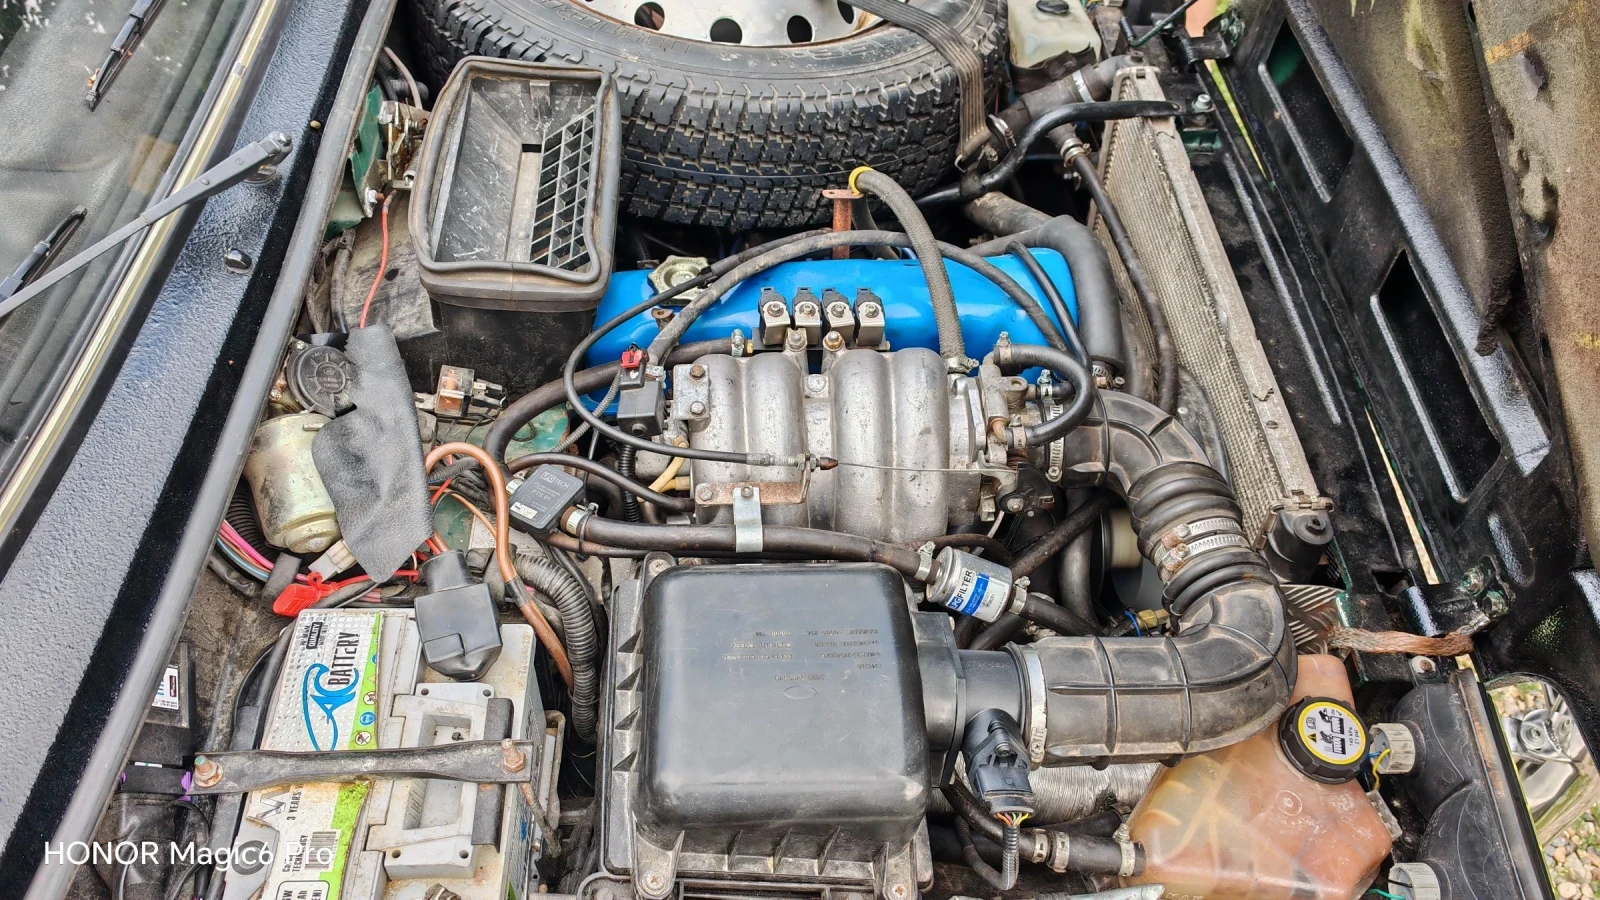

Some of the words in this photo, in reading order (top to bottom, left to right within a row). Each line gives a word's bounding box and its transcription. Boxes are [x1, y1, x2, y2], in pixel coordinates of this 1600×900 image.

[308, 623, 320, 647] QUALITY
[328, 632, 360, 685] BATTERY
[288, 792, 302, 813] YEARS
